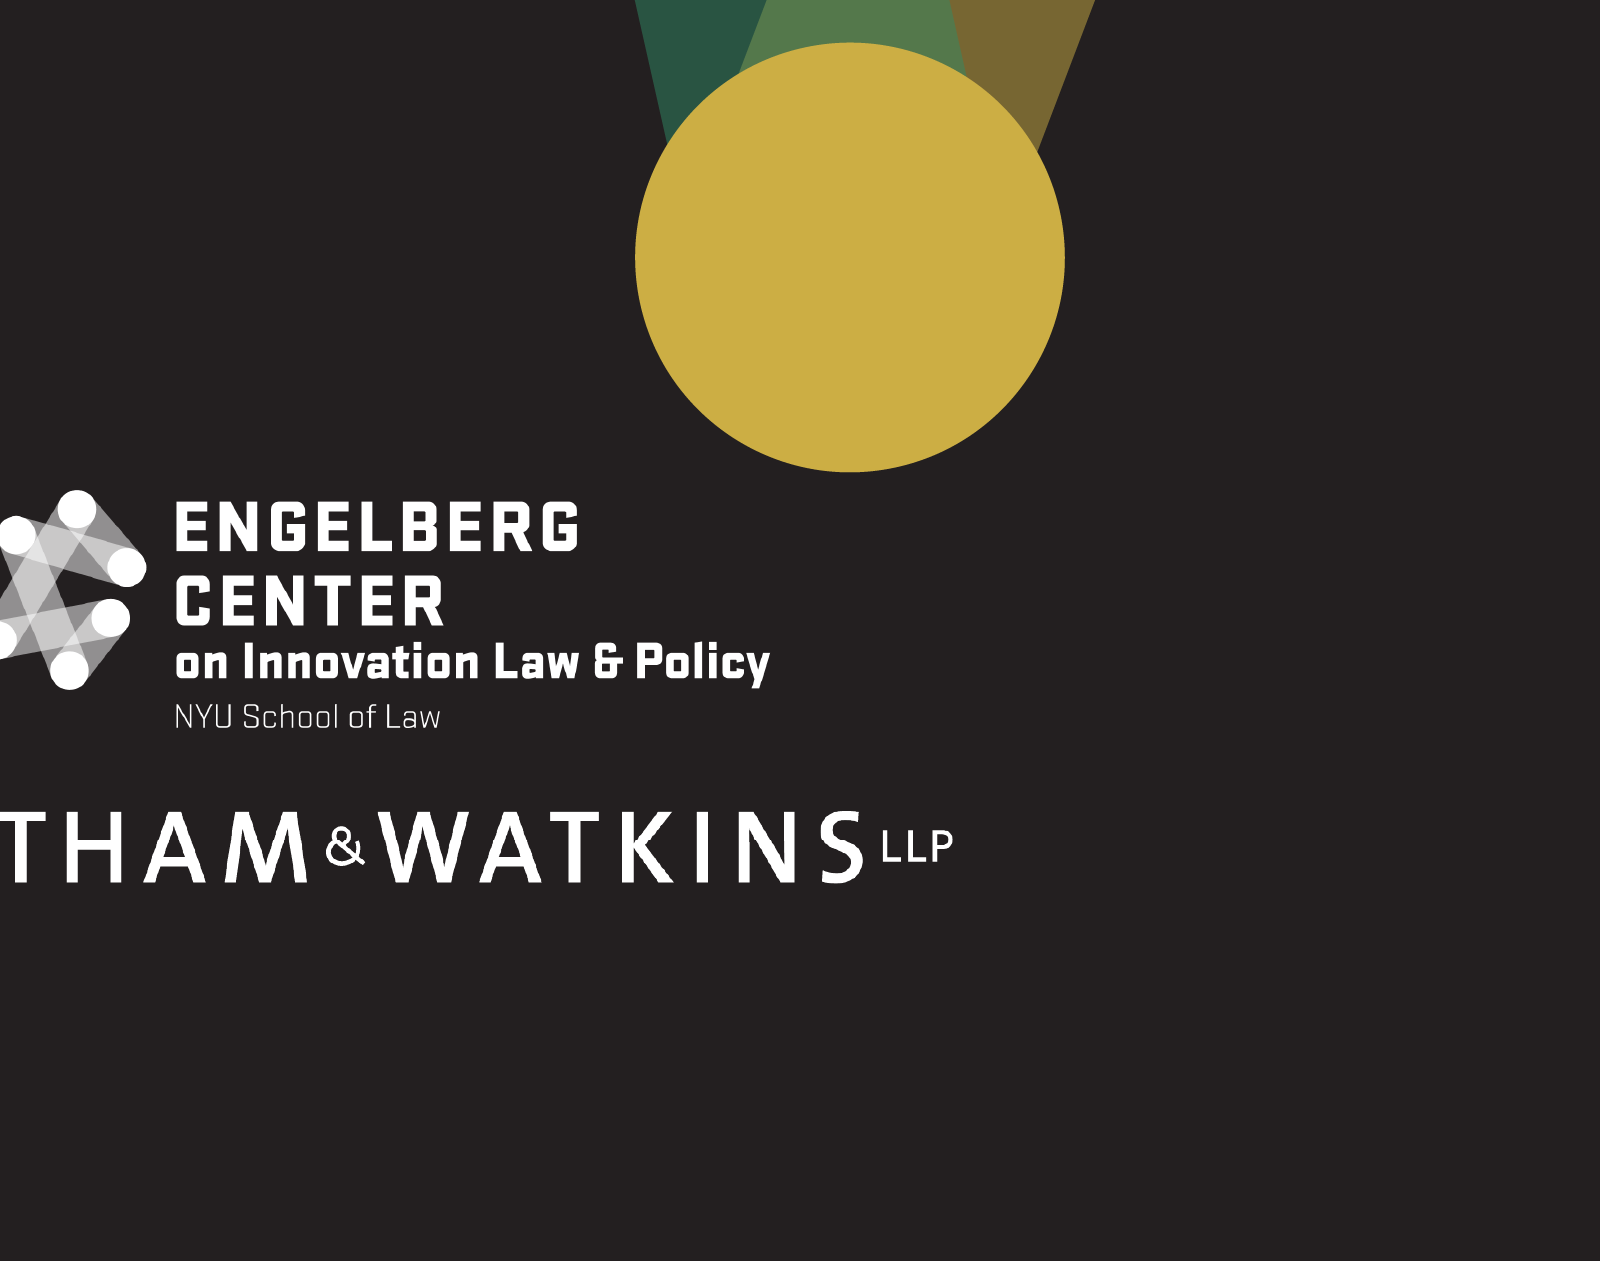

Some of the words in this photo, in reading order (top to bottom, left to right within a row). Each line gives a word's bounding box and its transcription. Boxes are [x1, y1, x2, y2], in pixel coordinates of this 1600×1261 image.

[176, 501, 577, 551] ENGELBERG
[176, 575, 443, 626] CENTER
[176, 652, 227, 679] on
[245, 642, 478, 679] Innovation
[496, 642, 579, 679] Law
[595, 642, 623, 678] &
[637, 641, 770, 689] Policy
[176, 704, 231, 728] NYU
[244, 704, 338, 728] School
[350, 704, 376, 728] of
[387, 704, 440, 728] Law
[378, 811, 863, 884] WATKINS
[883, 830, 953, 862] LLP
